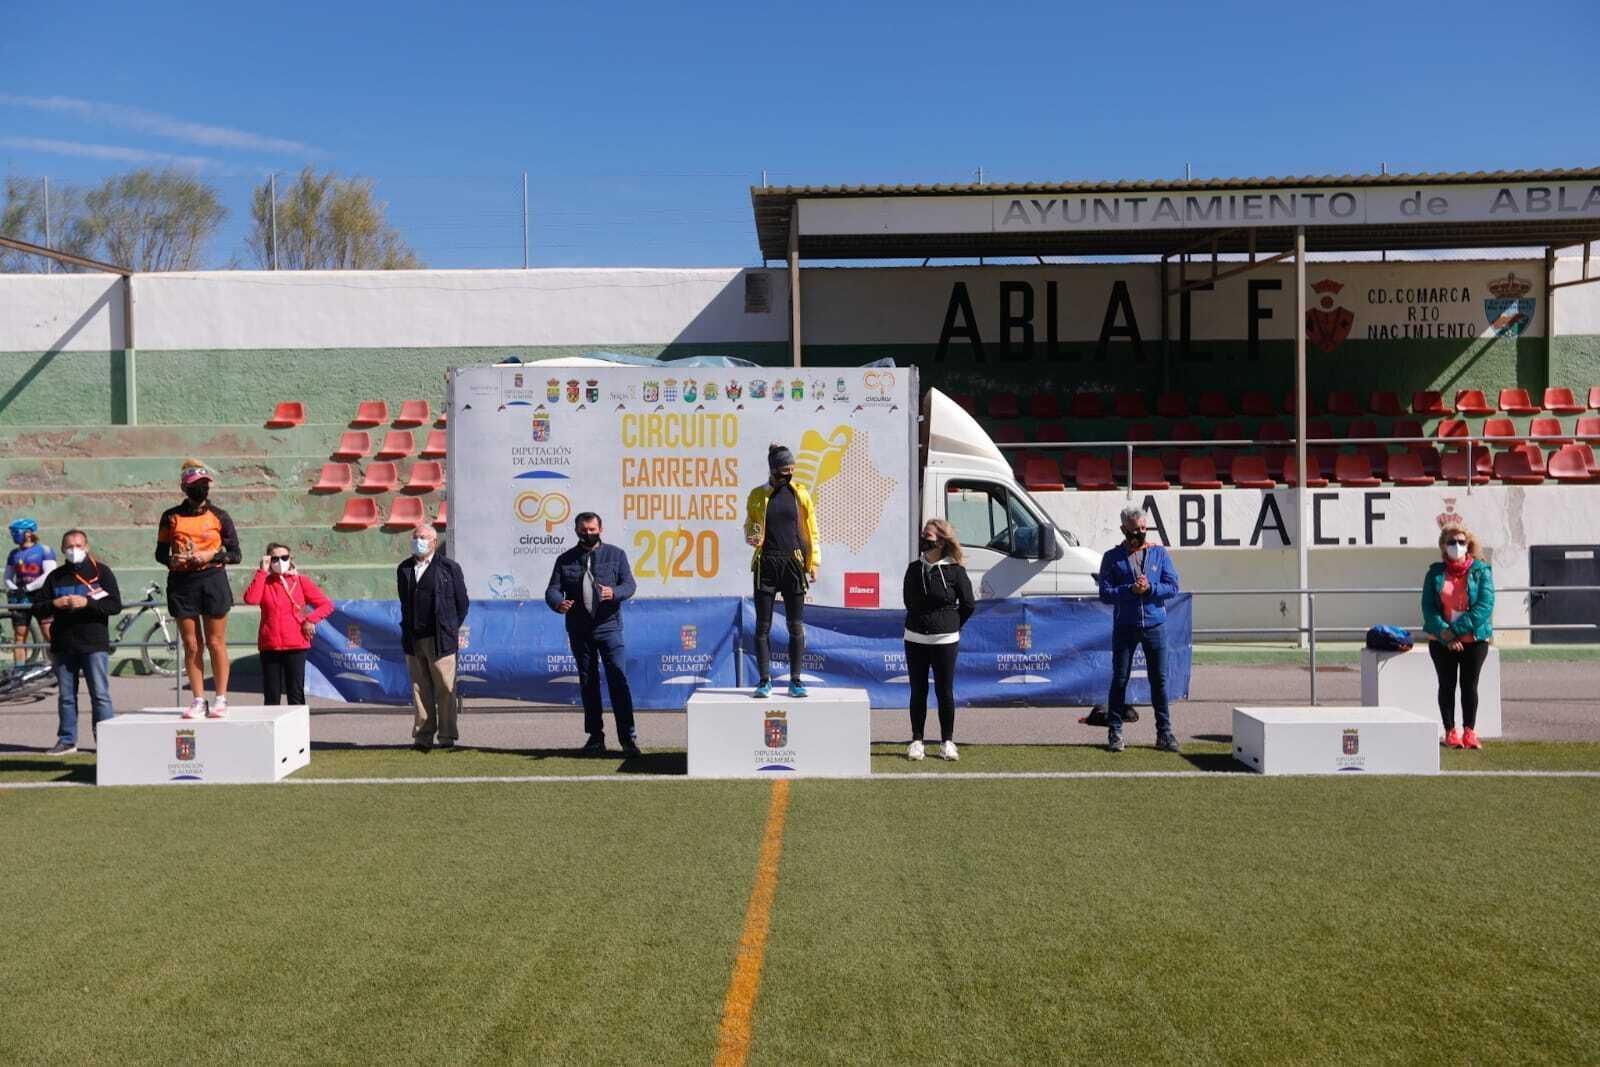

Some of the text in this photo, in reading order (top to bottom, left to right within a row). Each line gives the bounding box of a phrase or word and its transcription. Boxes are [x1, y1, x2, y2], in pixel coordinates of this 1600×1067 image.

[1001, 185, 1600, 225] AYUNTAMIENTO de ABLA
[934, 281, 1147, 363] ABLA
[1367, 322, 1476, 339] NACIMIENTO
[621, 413, 739, 448] CIRCUITO
[511, 446, 572, 456] DIPUTACIÓN
[513, 456, 570, 466] DE ALMERÍA
[622, 457, 738, 487] CARRERAS
[623, 494, 737, 520] POPULARES
[1141, 493, 1291, 546] ABLA
[513, 546, 567, 556] provinciale
[633, 527, 720, 581] 2020
[549, 664, 559, 672] DE
[662, 664, 673, 672] DE
[998, 664, 1008, 672] DE
